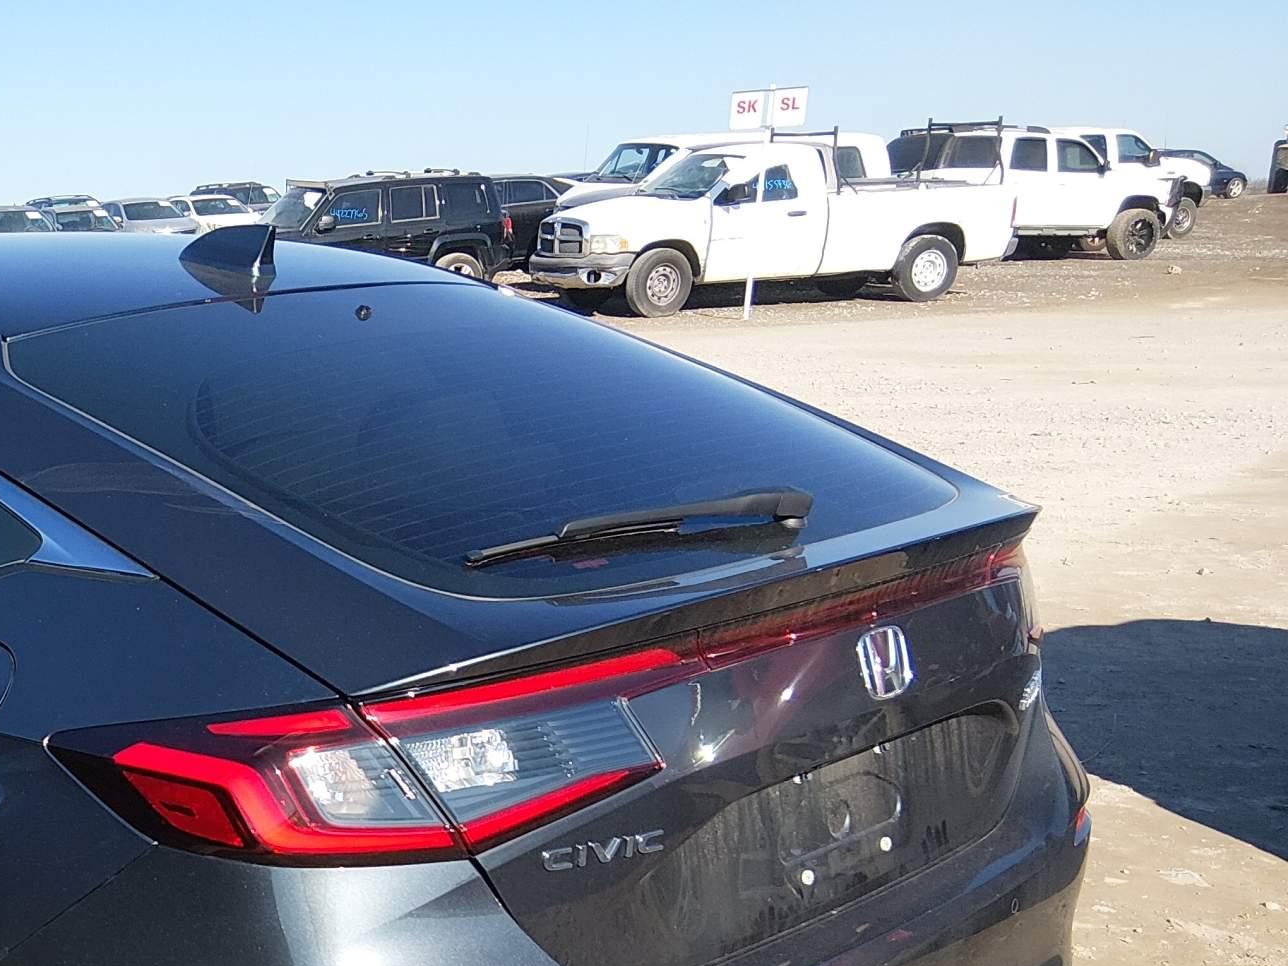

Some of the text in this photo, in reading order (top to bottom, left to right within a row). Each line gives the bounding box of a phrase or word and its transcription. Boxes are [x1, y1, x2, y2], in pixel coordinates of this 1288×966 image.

[736, 99, 759, 114] SK
[779, 96, 800, 112] SL
[541, 828, 665, 872] CIVIC
